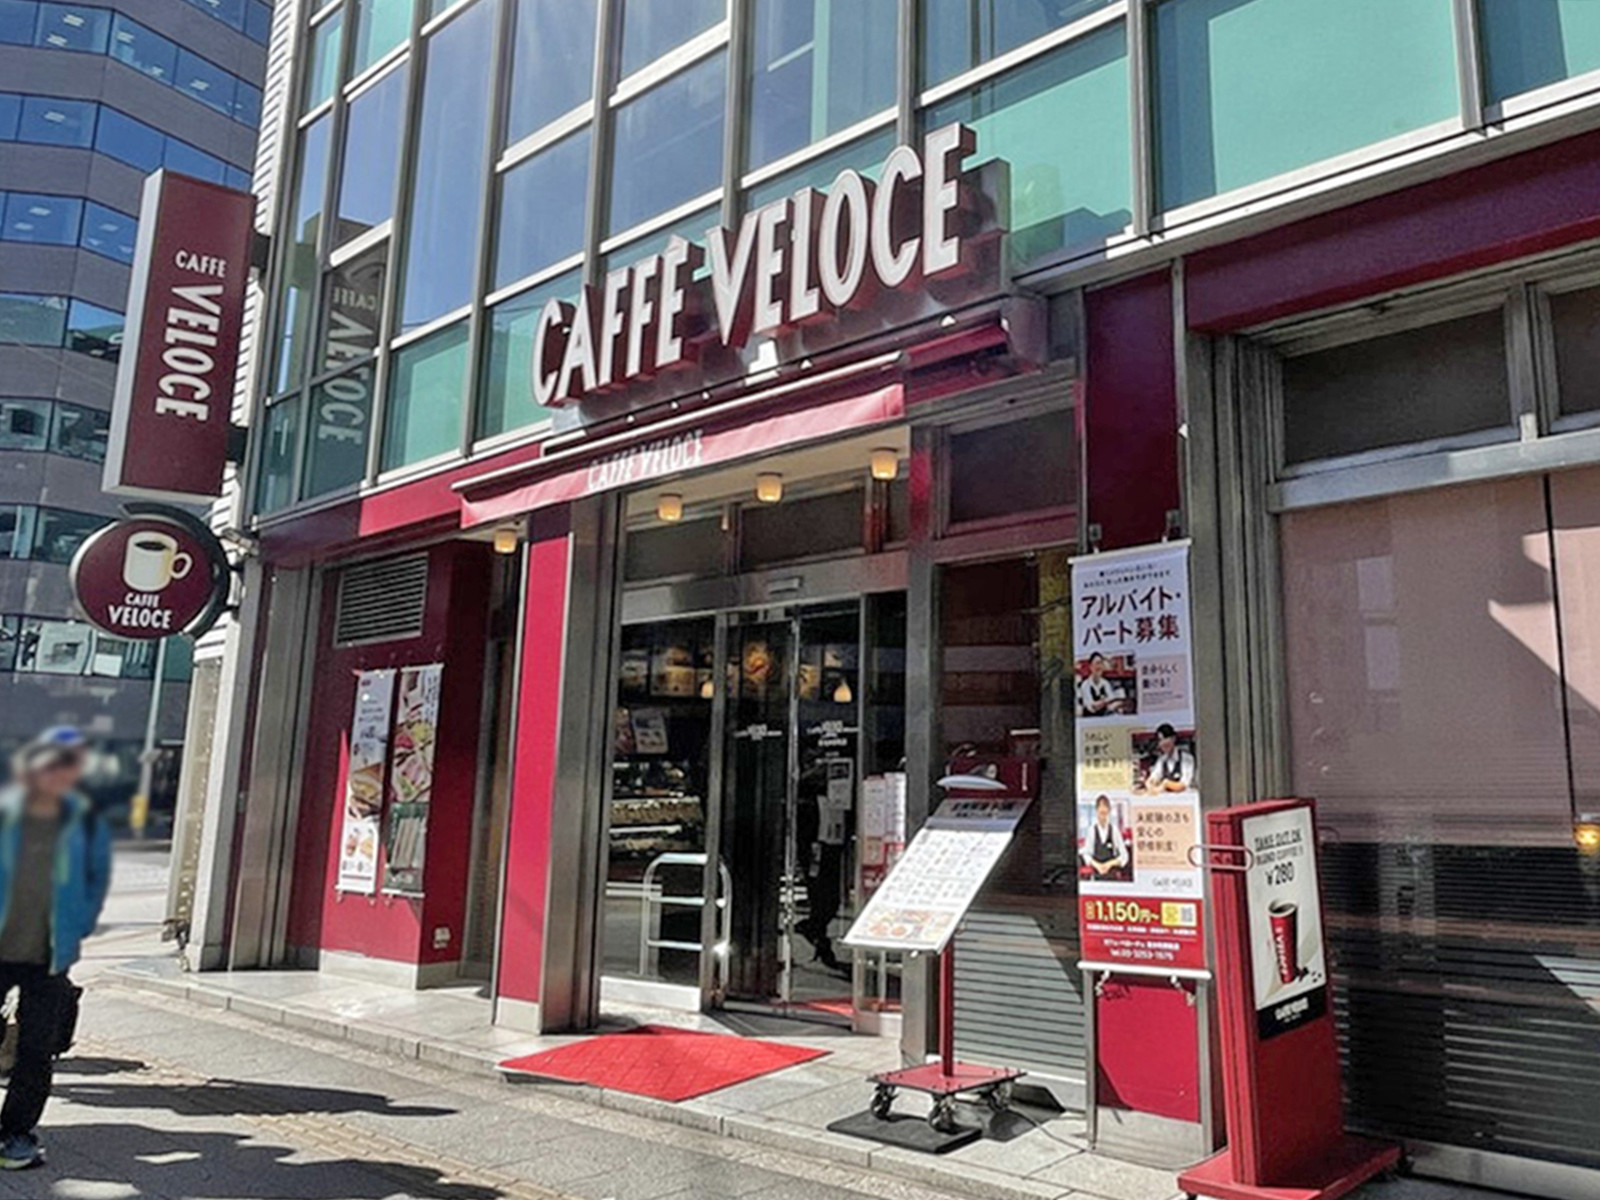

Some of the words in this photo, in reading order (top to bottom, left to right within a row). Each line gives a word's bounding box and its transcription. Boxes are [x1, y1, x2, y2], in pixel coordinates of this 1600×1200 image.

[705, 122, 970, 346] VELOCE
[175, 249, 227, 278] CAFFE
[155, 284, 224, 422] VELOCE
[640, 429, 703, 478] VELOCE
[108, 604, 172, 629] VELOCE
[1083, 614, 1180, 646] パート募集
